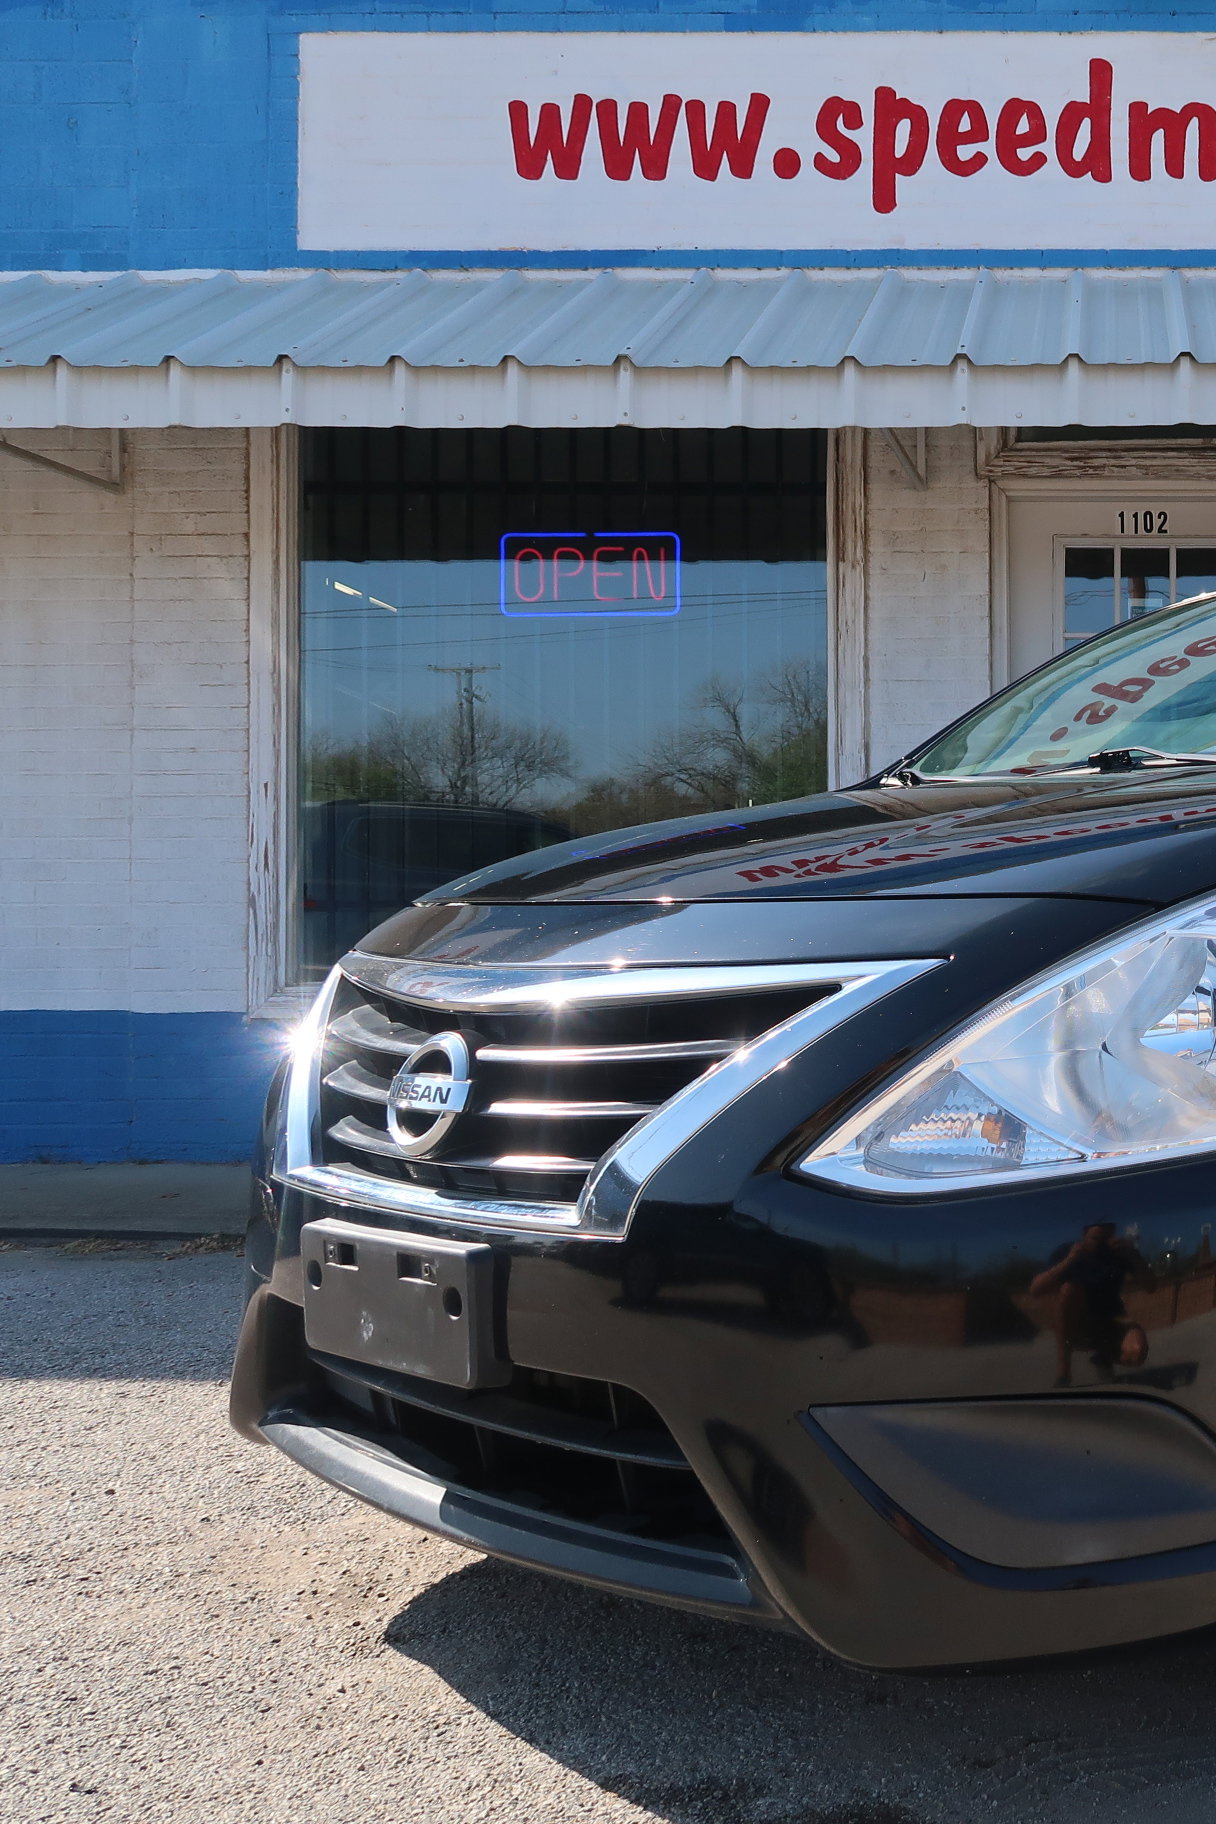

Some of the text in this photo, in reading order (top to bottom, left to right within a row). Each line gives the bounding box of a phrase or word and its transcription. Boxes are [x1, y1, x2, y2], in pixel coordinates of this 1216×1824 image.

[1118, 510, 1168, 534] 1102
[514, 546, 666, 602] OPEN
[389, 1080, 452, 1104] NISSAN
